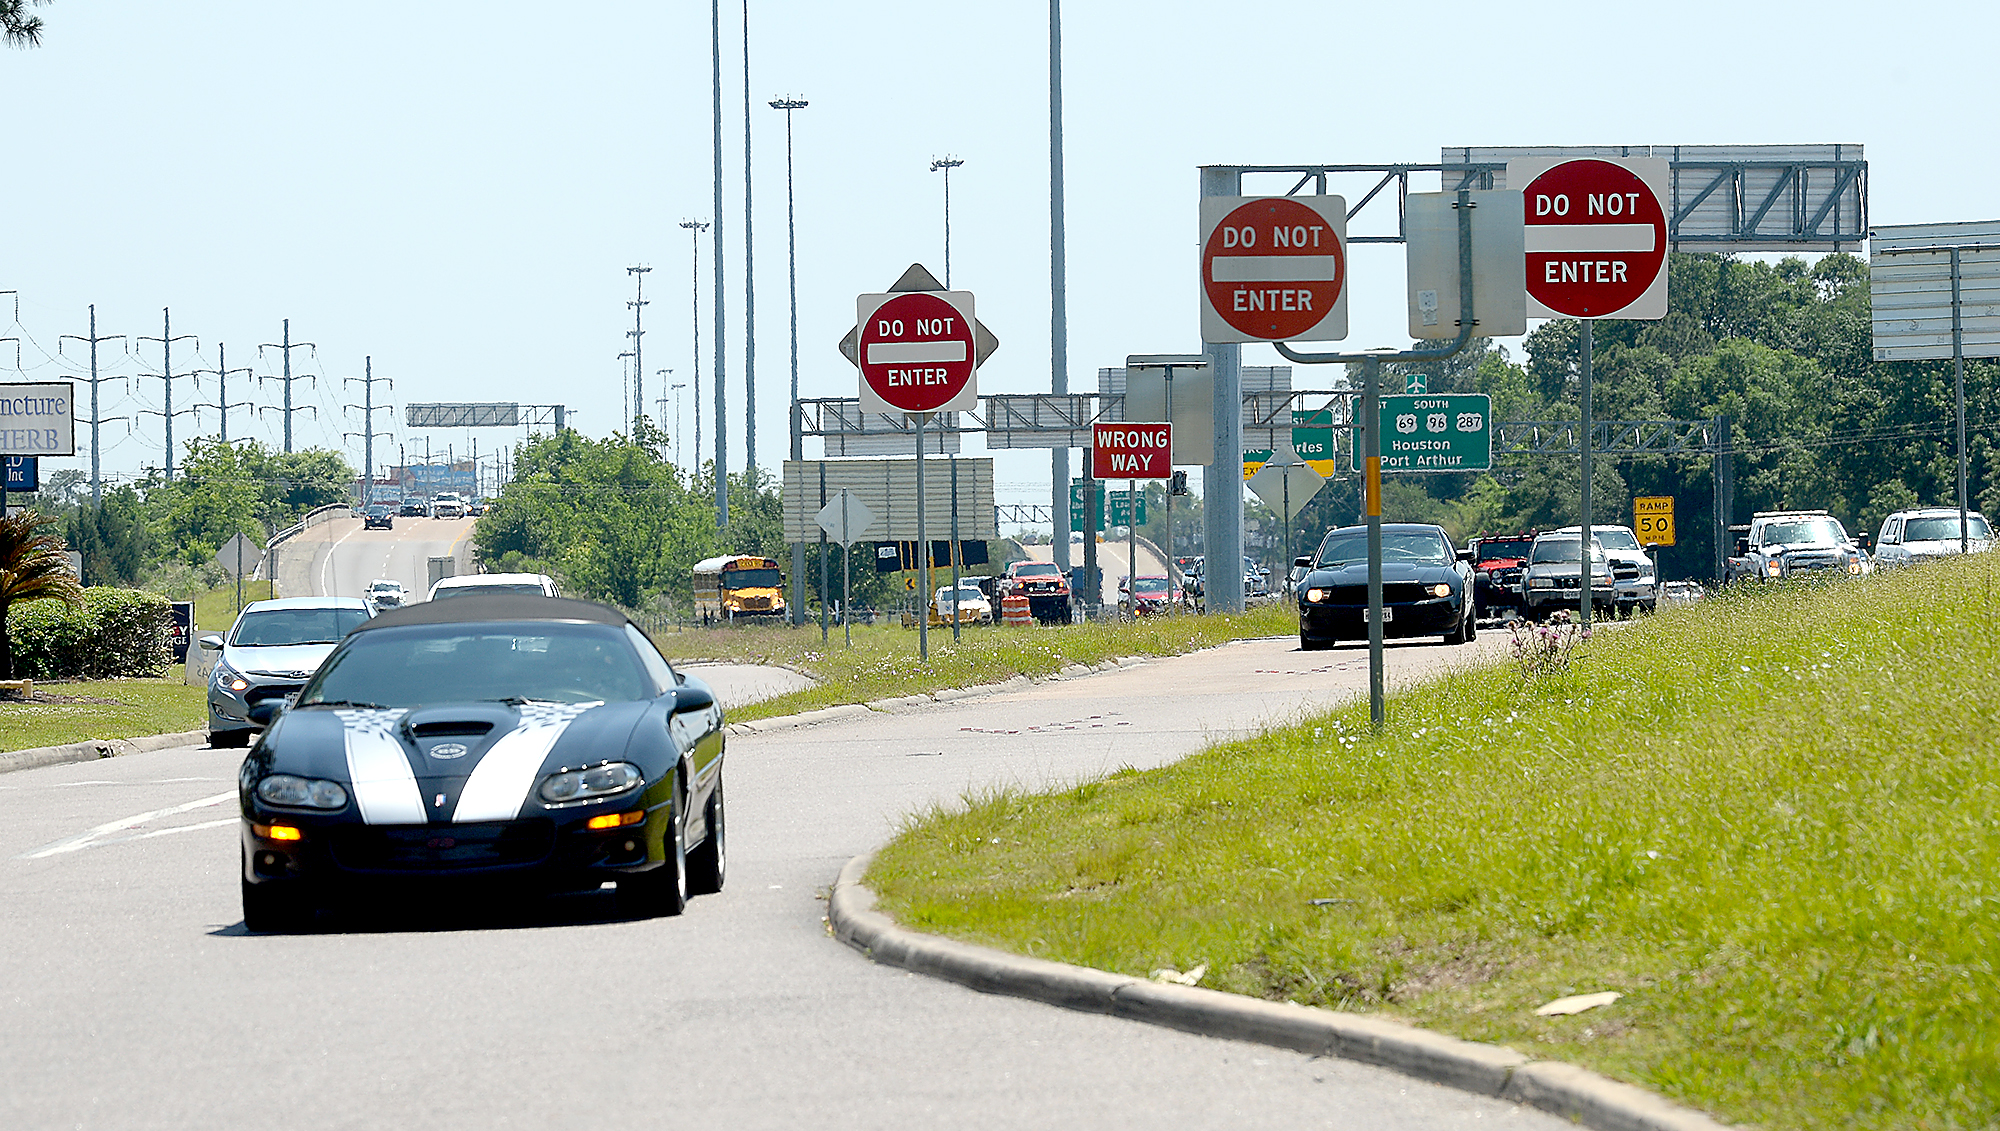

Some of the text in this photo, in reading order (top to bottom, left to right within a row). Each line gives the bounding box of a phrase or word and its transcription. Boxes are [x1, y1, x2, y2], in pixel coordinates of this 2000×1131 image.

[1536, 192, 1640, 216] DO NOT
[1223, 225, 1324, 248] DO NOT
[1545, 260, 1628, 283] ENTER
[1233, 289, 1313, 312] ENTER
[878, 317, 954, 337] DO NOT
[887, 368, 948, 387] ENTER
[1413, 400, 1450, 410] SOUTH
[1398, 416, 1482, 429] 69 96 287
[1097, 430, 1169, 449] WRONG
[1392, 440, 1451, 451] Houston
[1110, 453, 1154, 472] WAY
[1380, 453, 1463, 467] Port Arthur
[8, 467, 24, 482] Inc
[1639, 502, 1669, 511] RAMP
[1641, 517, 1669, 532] 50
